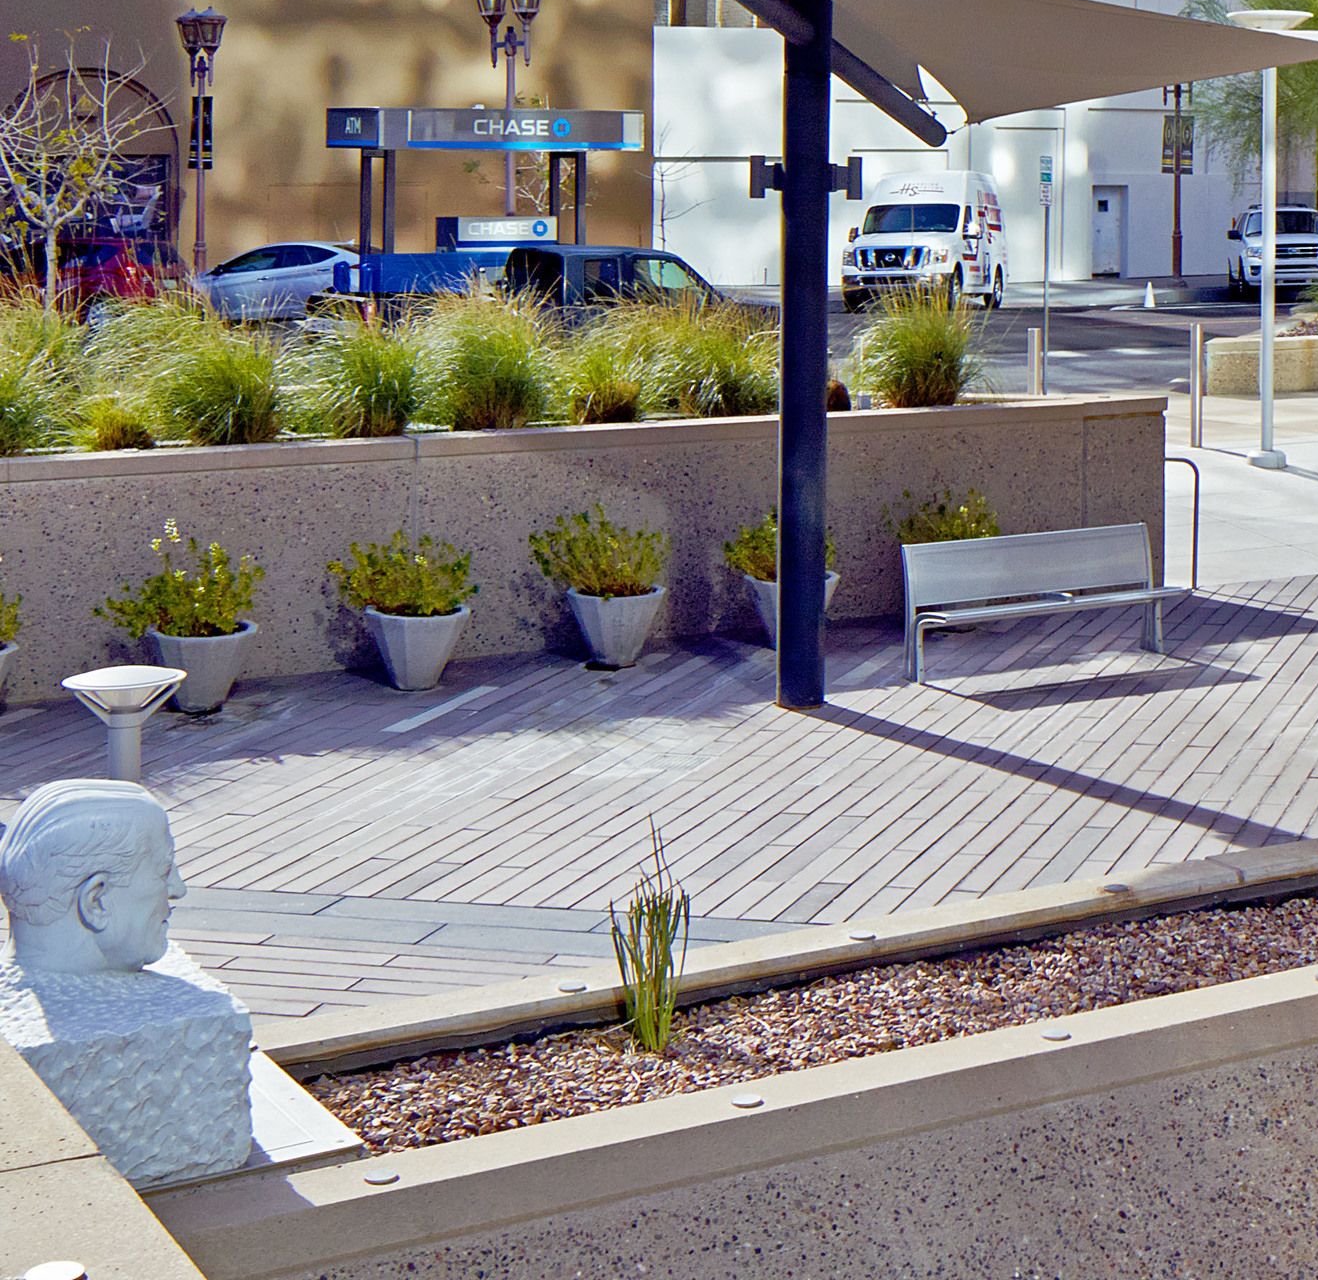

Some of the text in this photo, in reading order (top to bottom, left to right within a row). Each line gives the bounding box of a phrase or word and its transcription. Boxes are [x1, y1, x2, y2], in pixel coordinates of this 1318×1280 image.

[345, 117, 361, 134] ATM
[474, 119, 550, 135] CHASE
[468, 222, 529, 236] CHASE
